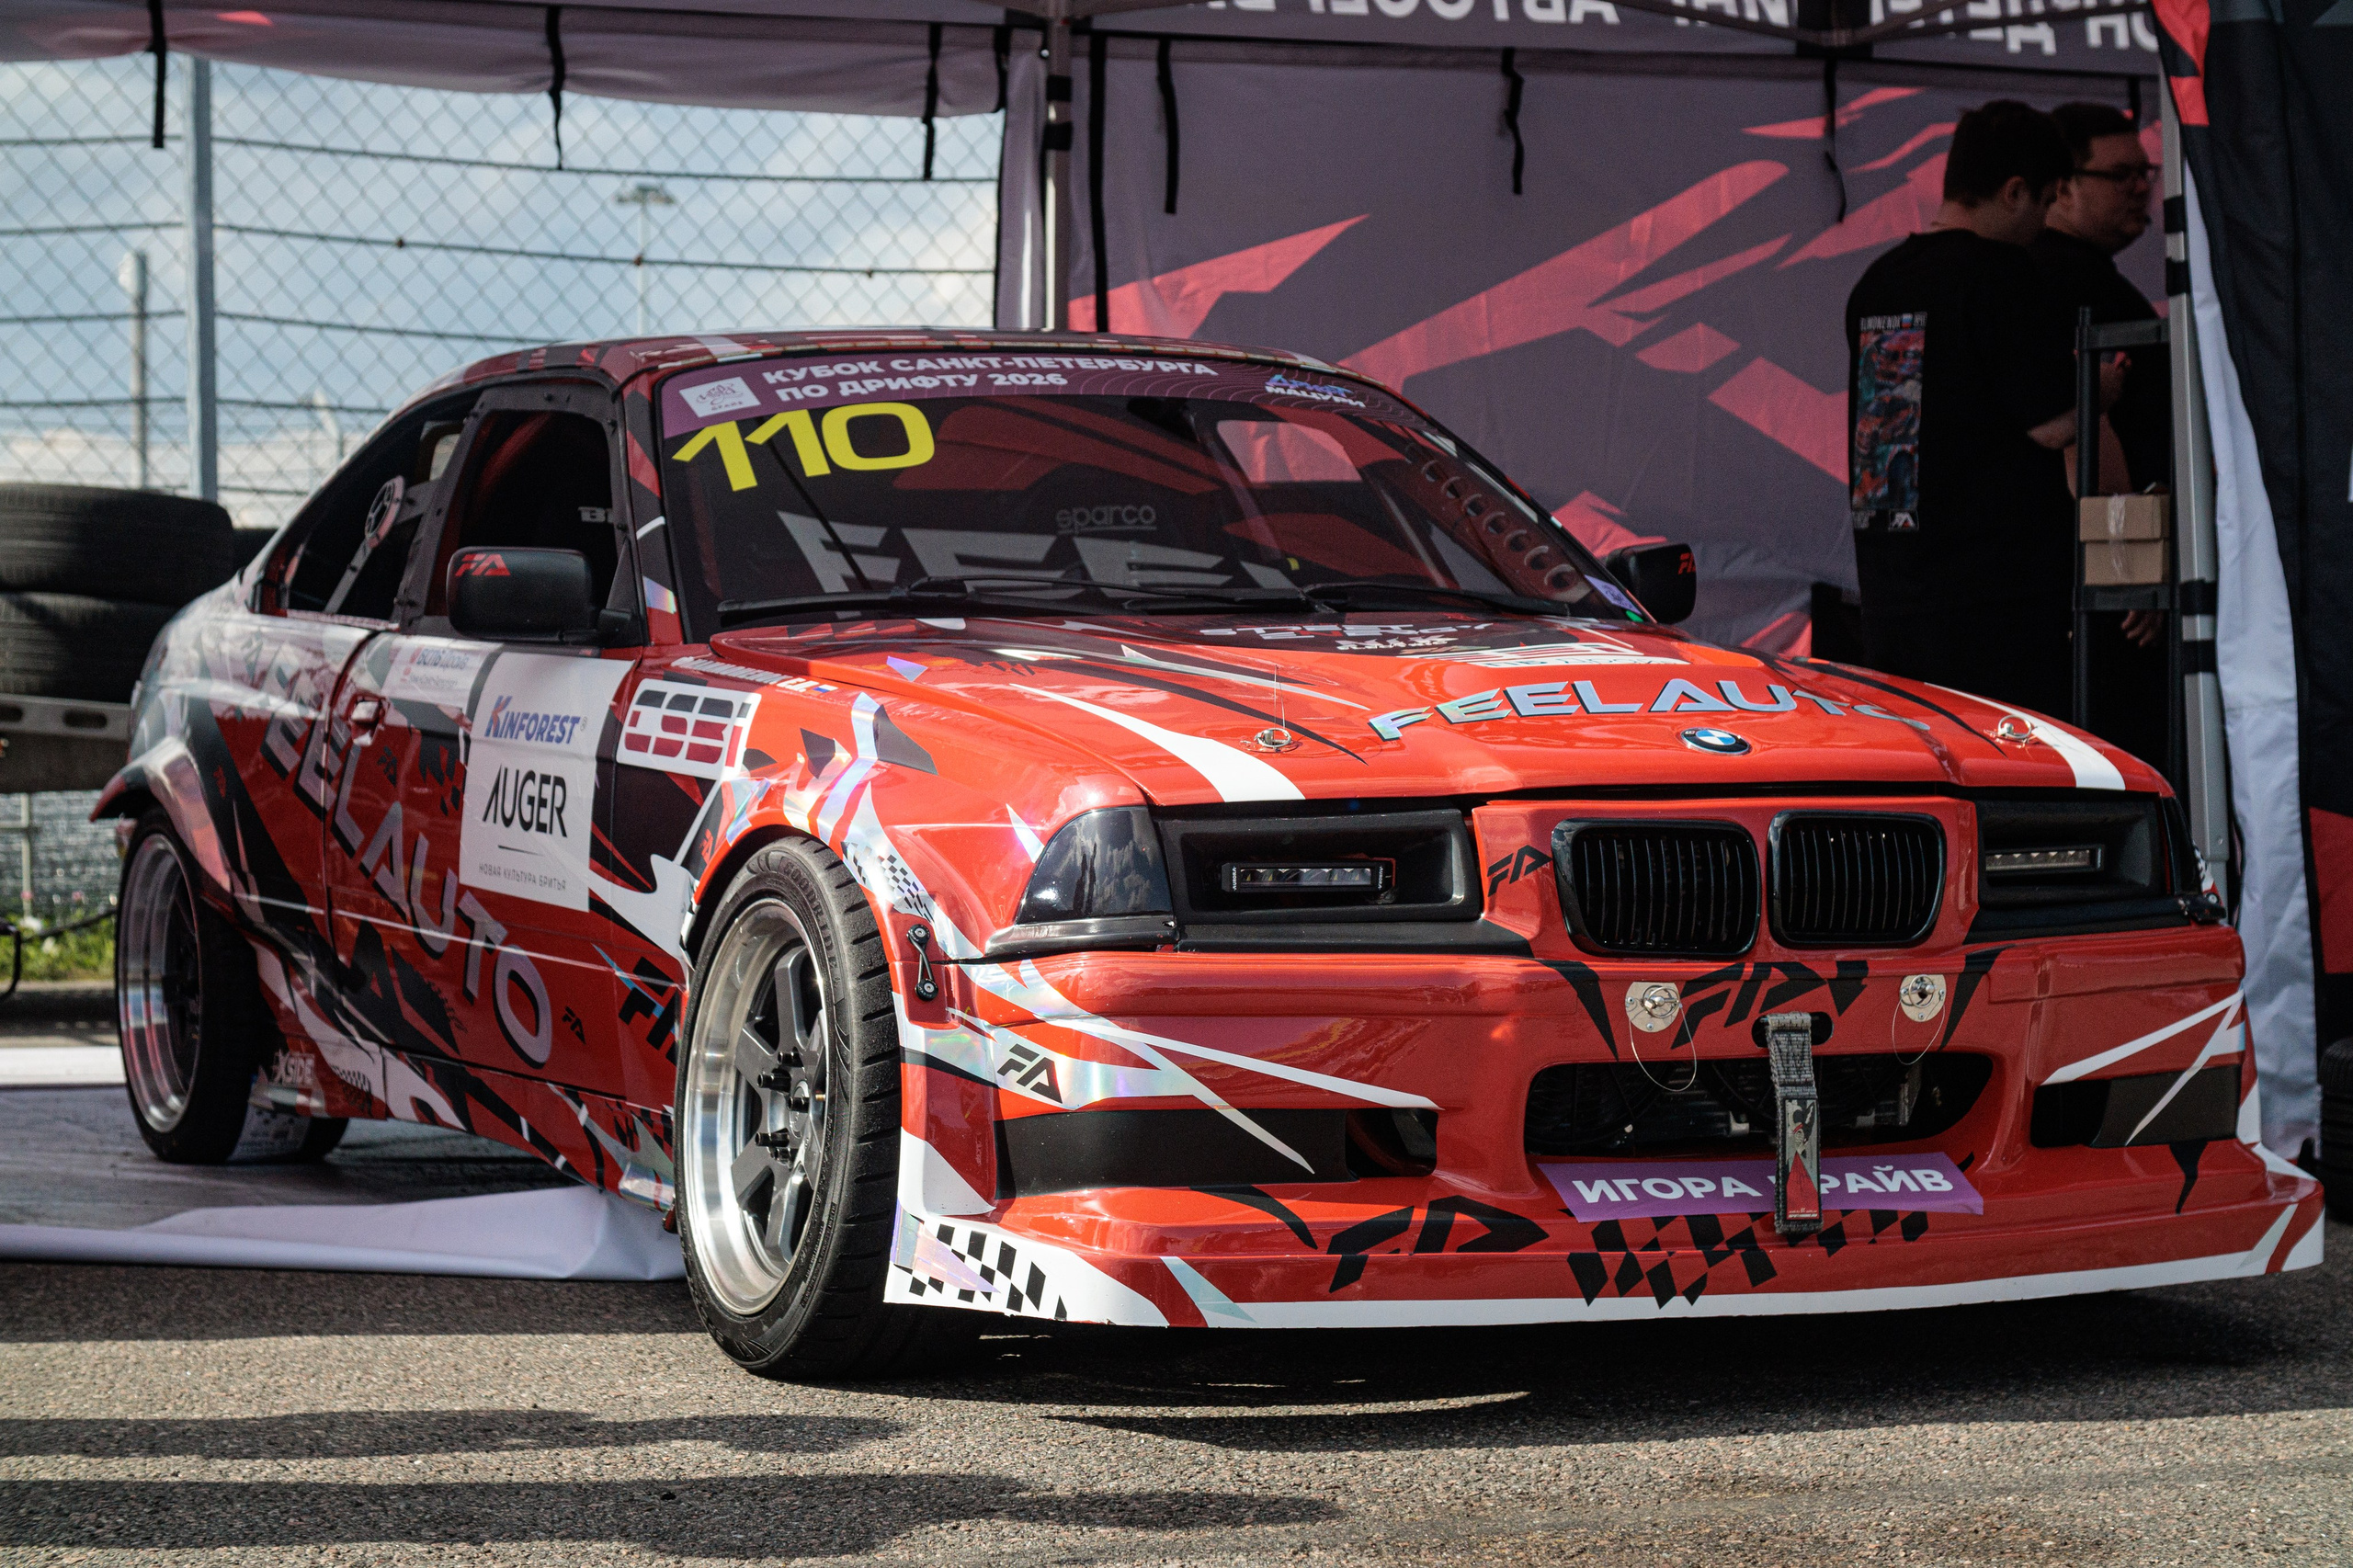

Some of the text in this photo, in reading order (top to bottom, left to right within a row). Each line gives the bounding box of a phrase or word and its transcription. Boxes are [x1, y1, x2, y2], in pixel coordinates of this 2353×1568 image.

[762, 356, 1219, 384] КУБОК САНКТ-ПЕТЕРБУРГА
[775, 372, 1068, 402] ПО ДРИФТУ 2026
[672, 402, 935, 492] 110
[1055, 505, 1157, 535] sparco
[484, 695, 580, 744] KINFOREST
[482, 764, 568, 838] AUGER
[479, 862, 566, 892] НОВАЯ КУЛЬТУРА БРИТЬЯ
[1572, 1165, 1954, 1204] ИГОРА РАЙВ
